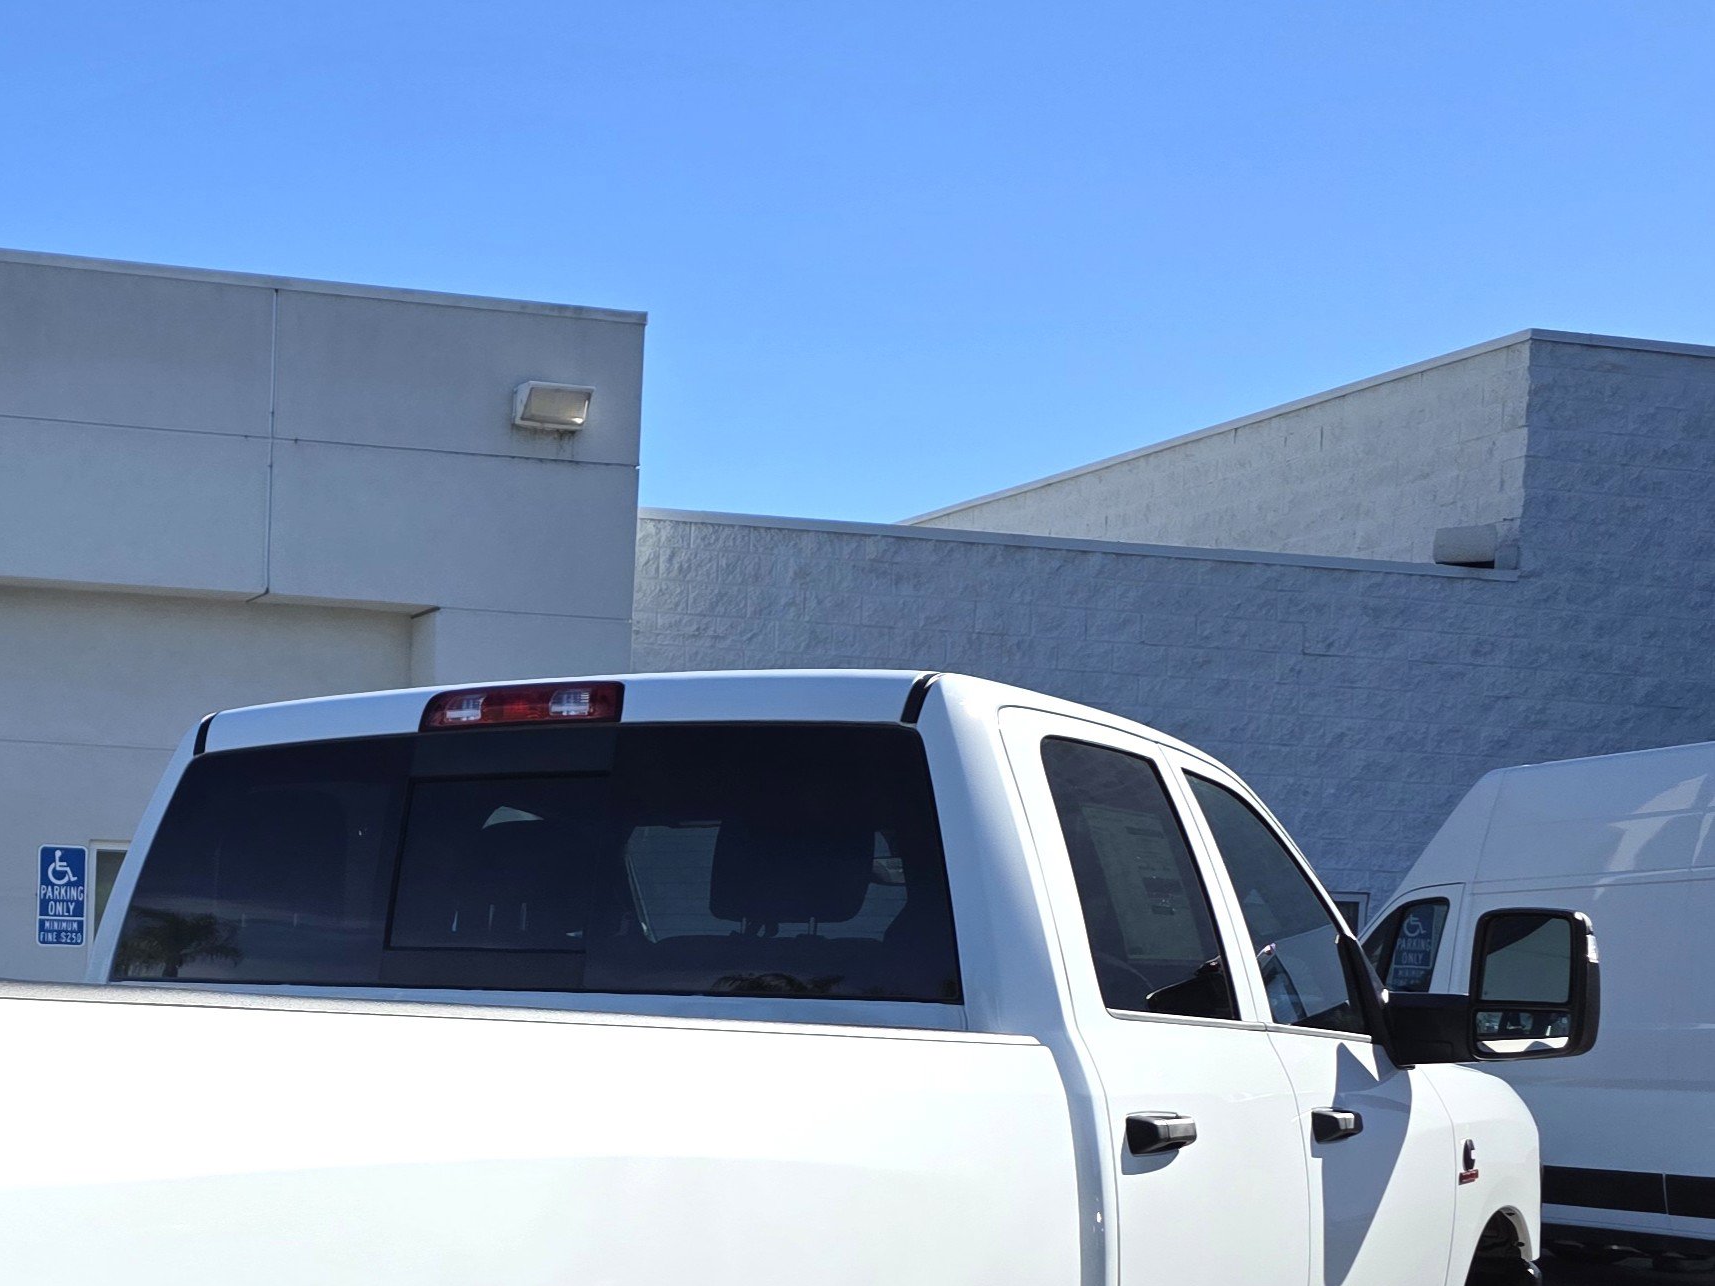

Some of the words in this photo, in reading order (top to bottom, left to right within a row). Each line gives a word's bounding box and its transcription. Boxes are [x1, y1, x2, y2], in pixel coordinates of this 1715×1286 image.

[40, 885, 84, 901] PARKING
[48, 901, 76, 916] ONLY
[44, 920, 78, 931] MINIMUM
[40, 931, 58, 942] FINE
[60, 932, 82, 943] $250
[1397, 937, 1431, 952] PARKING
[1401, 952, 1424, 965] ONLY
